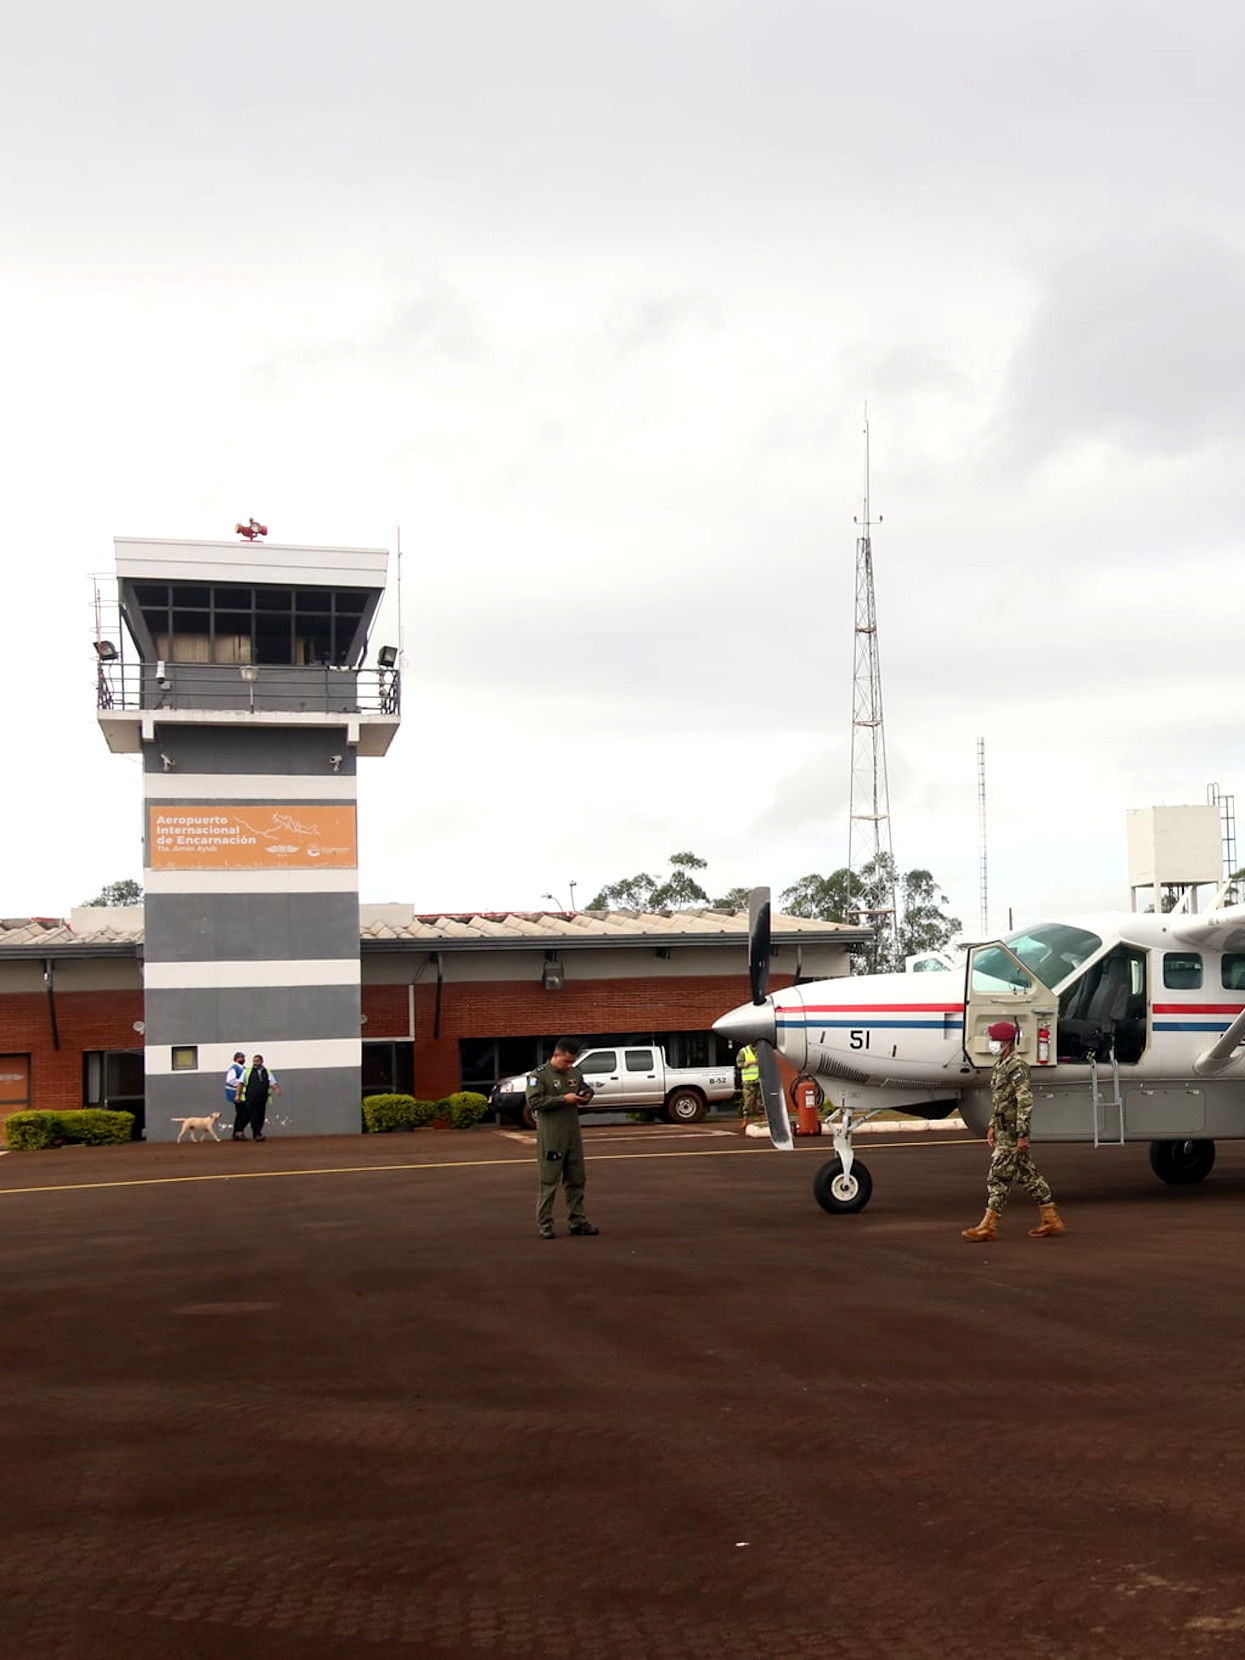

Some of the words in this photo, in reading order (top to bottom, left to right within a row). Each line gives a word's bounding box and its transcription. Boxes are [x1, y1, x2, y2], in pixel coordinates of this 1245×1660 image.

[156, 816, 228, 826] Aeropuerto
[156, 826, 240, 835] Internacional
[156, 836, 173, 845] de
[176, 835, 257, 845] Encarnación
[850, 1030, 870, 1050] 51
[709, 1077, 727, 1085] B-52
